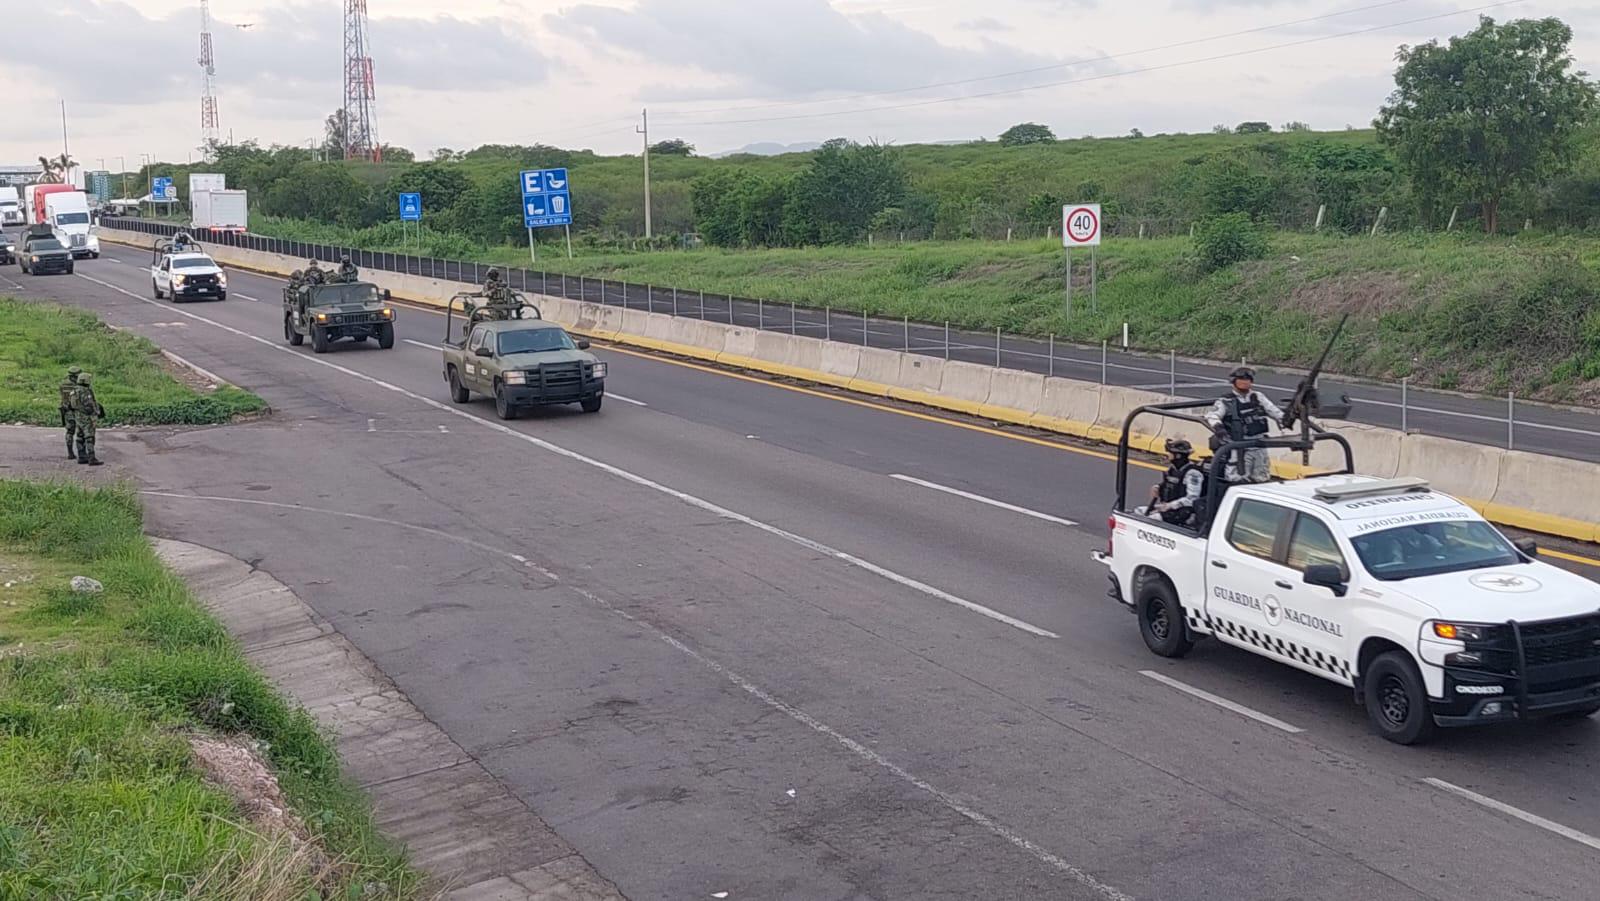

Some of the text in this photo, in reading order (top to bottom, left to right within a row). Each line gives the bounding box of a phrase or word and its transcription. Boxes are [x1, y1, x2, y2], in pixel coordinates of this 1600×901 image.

[524, 172, 541, 193] E
[1074, 216, 1090, 230] 40
[1213, 586, 1343, 638] GUARDIA NACIONAL
